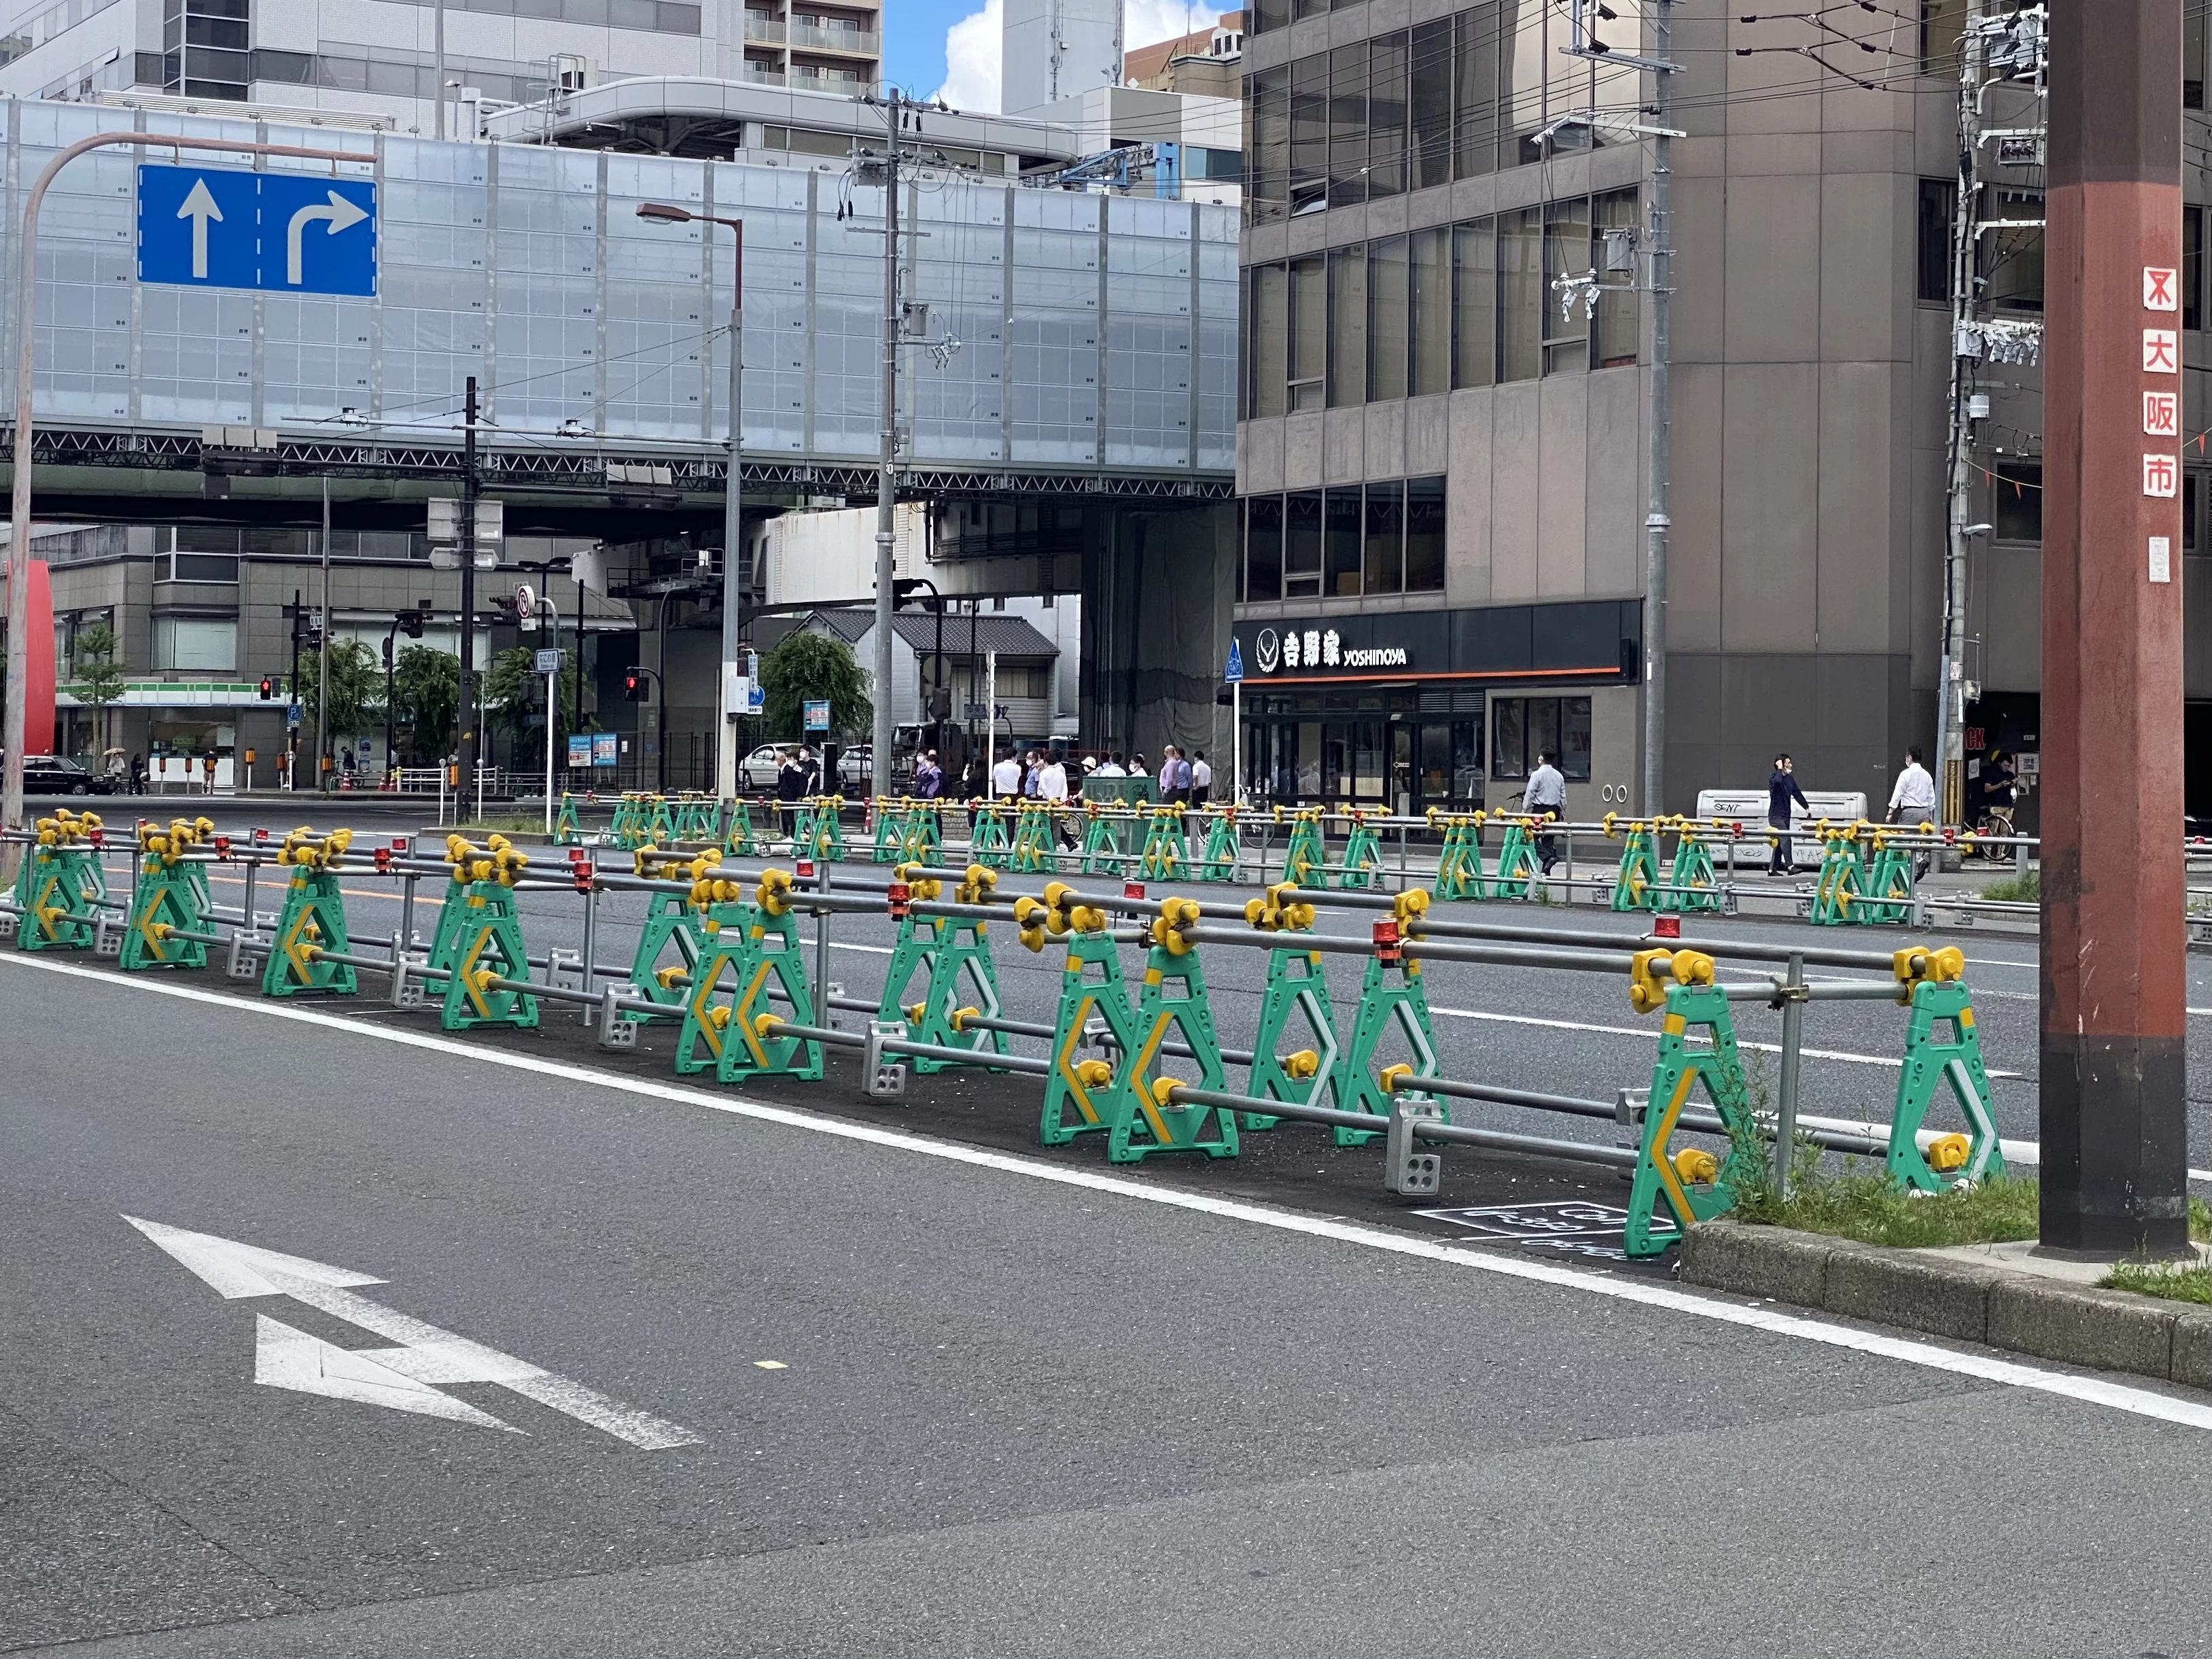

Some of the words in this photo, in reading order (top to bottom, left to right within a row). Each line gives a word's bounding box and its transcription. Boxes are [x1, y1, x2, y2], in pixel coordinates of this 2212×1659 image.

[2146, 334, 2173, 492] 大阪市
[1283, 629, 1340, 667] 吉野家
[1344, 648, 1407, 667] YOSHINOYA
